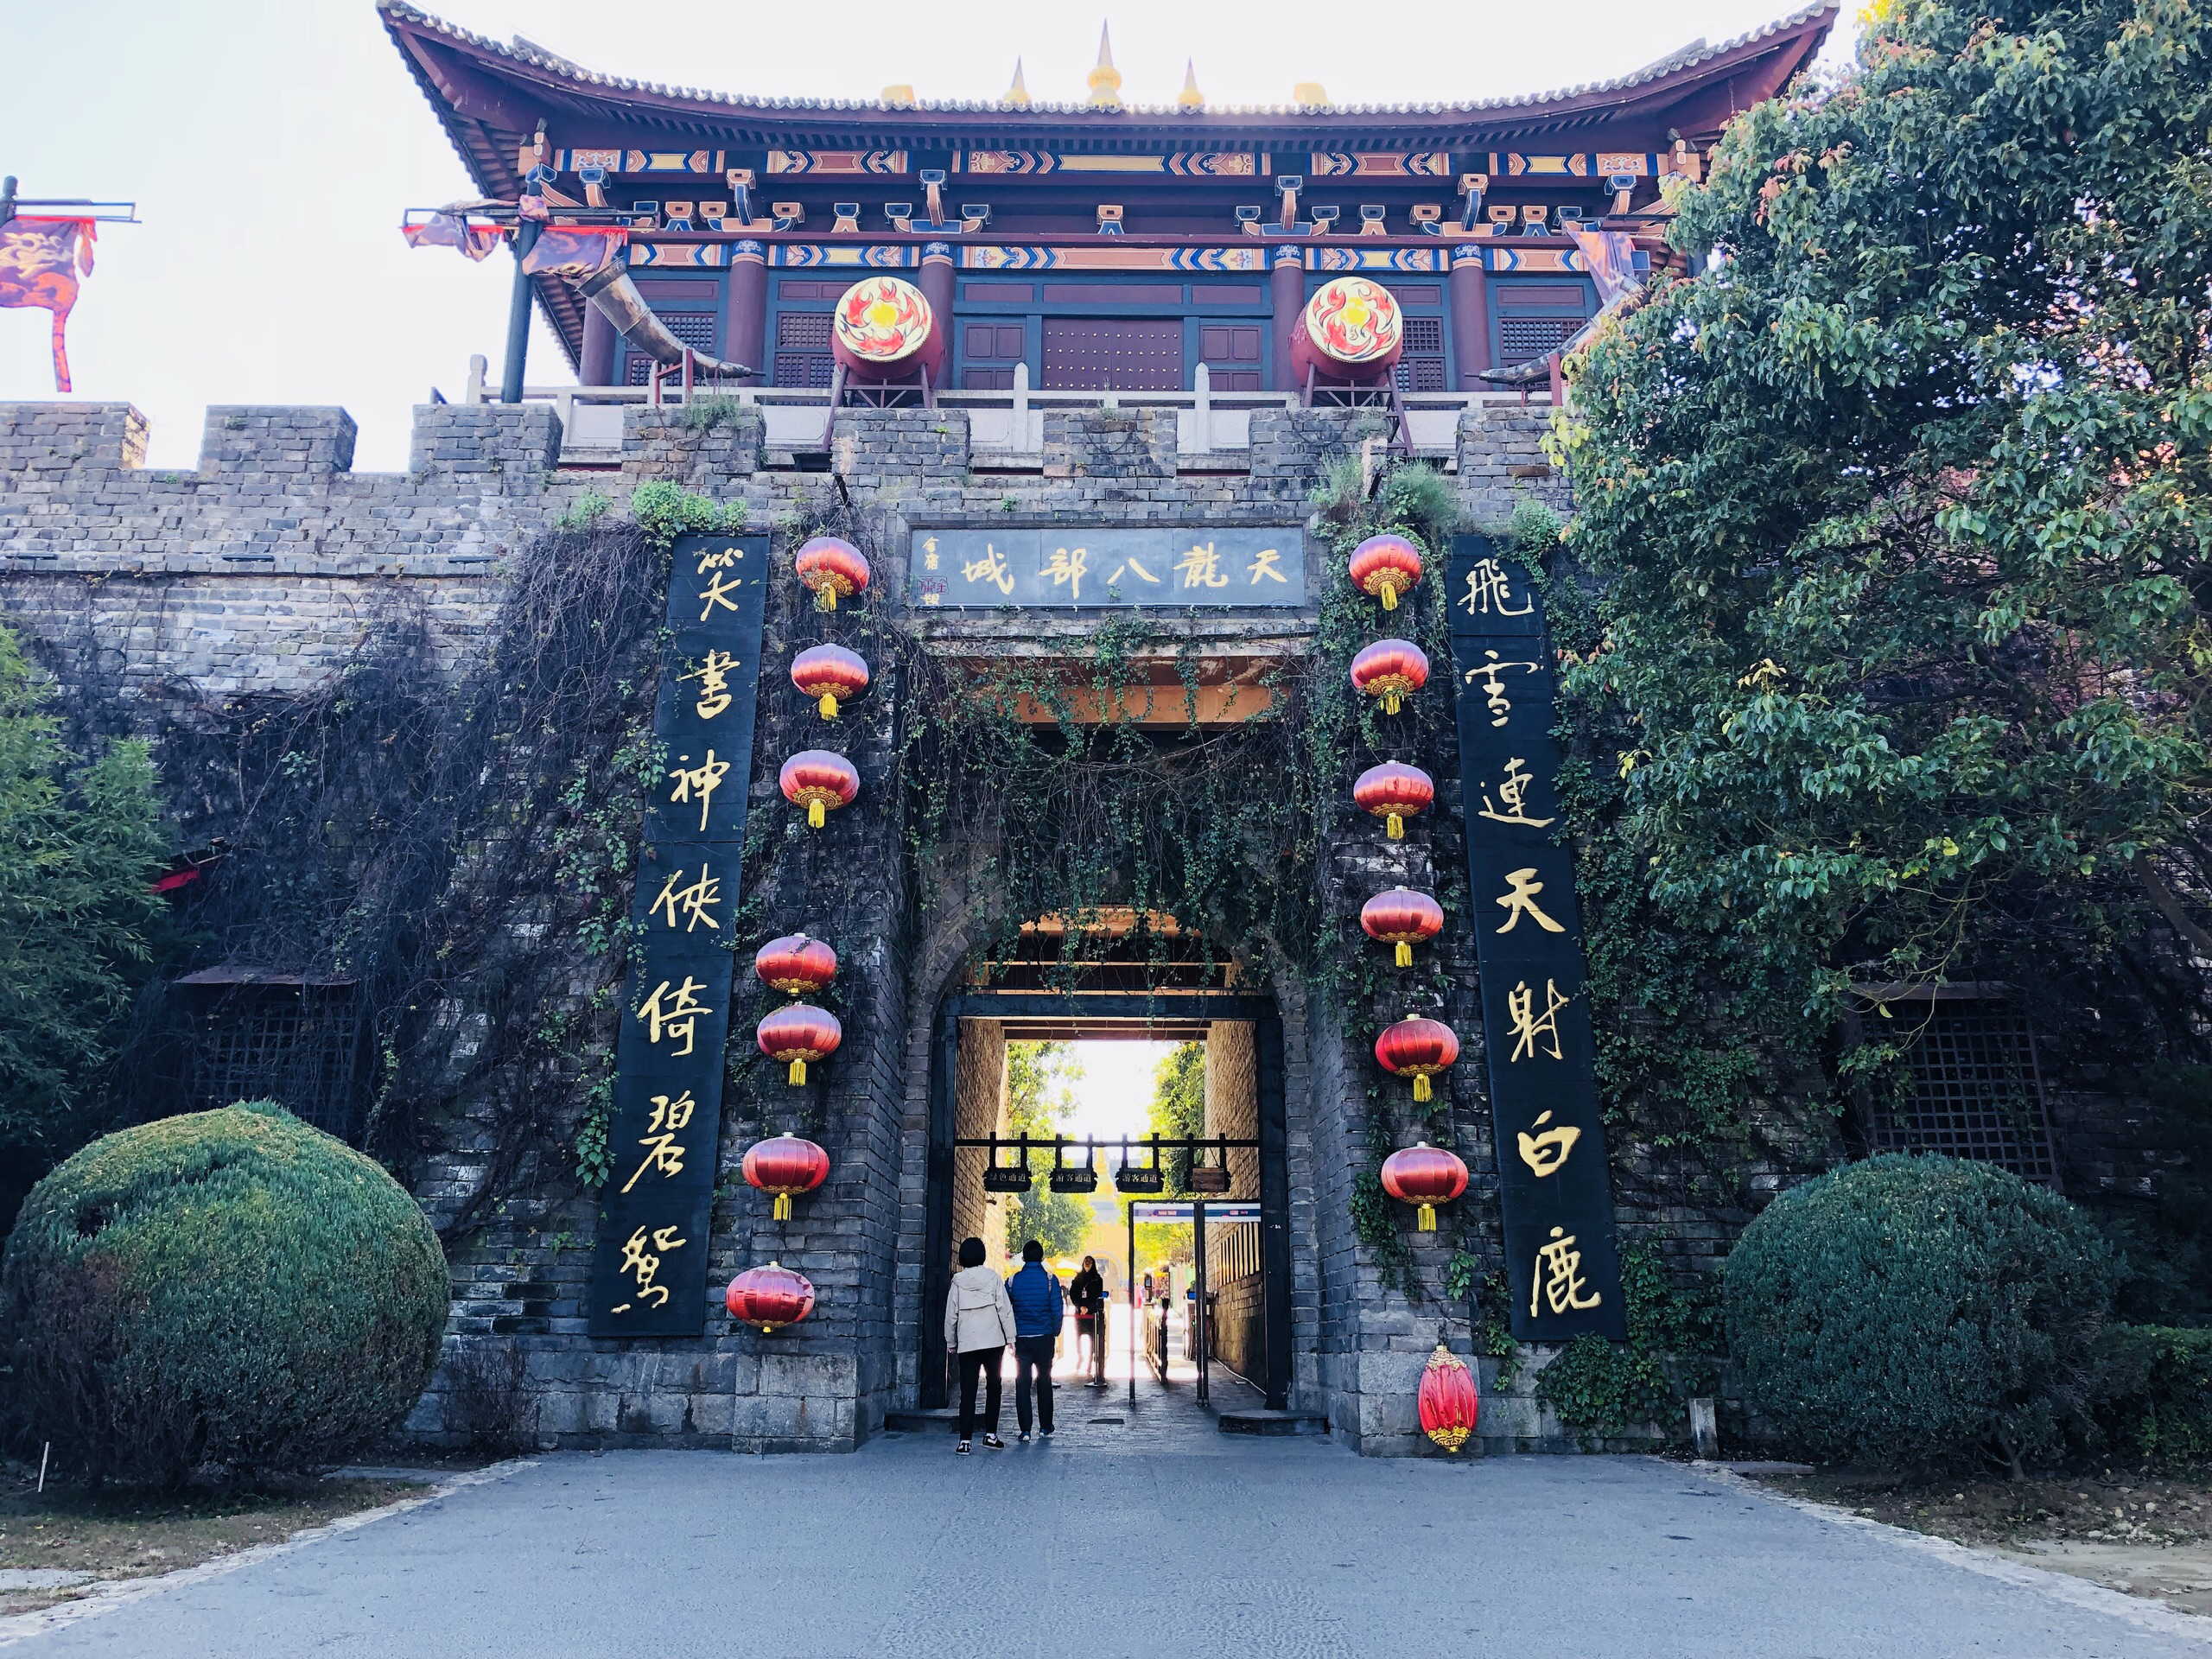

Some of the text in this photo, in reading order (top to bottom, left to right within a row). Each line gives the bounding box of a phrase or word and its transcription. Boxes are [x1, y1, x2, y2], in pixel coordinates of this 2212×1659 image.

[961, 542, 1288, 599] 天龍八部城
[1456, 557, 1602, 1318] 飛雪連天射白鹿
[1122, 1173, 1158, 1184] 游客通道
